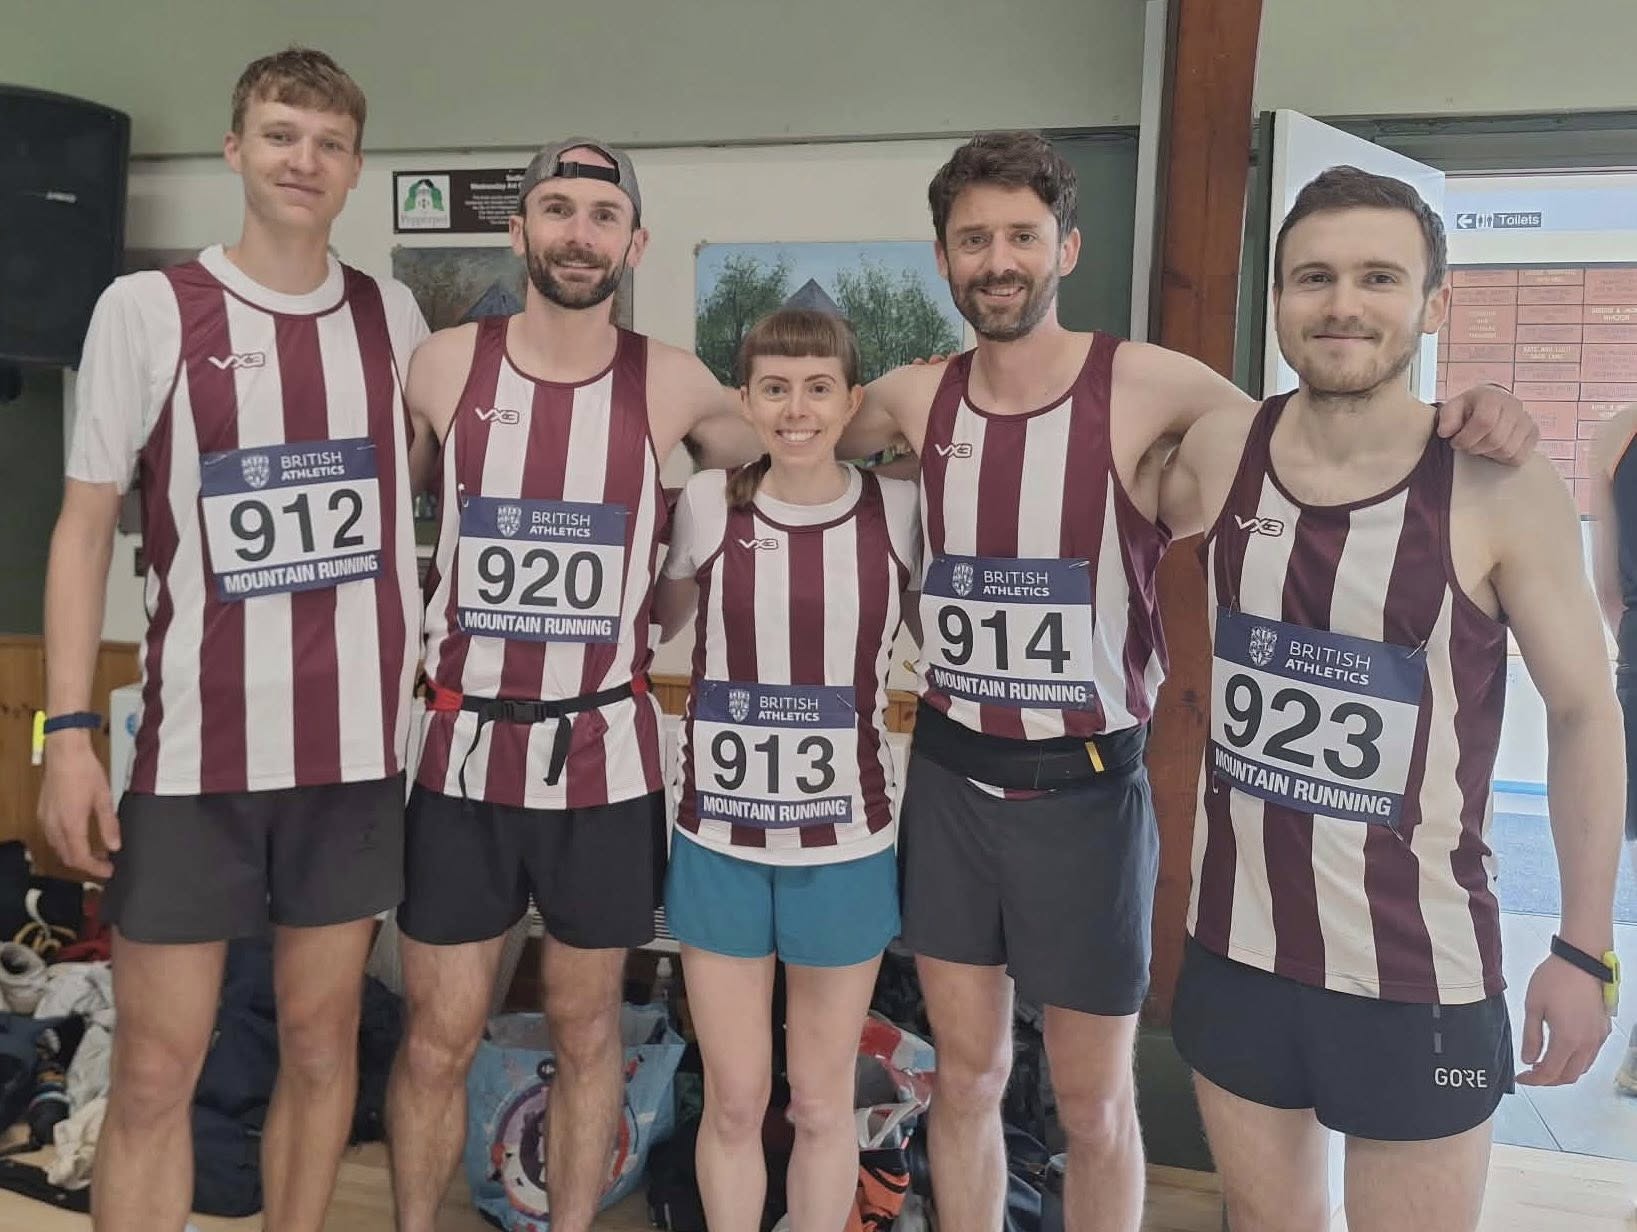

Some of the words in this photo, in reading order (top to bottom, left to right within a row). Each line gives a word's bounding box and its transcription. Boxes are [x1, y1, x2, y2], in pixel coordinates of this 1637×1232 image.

[1499, 213, 1541, 227] Toilets
[208, 352, 265, 370] VX3
[475, 407, 520, 424] VX3
[280, 451, 343, 470] BRITISH
[935, 443, 972, 458] VX3
[280, 465, 345, 481] ATHLETICS
[230, 488, 364, 562] 912
[532, 511, 591, 526] BRITISH
[1234, 514, 1285, 537] VX3
[529, 526, 591, 538] ATHLETICS
[738, 538, 779, 550] VX3
[223, 563, 316, 594] MOUNTAIN
[318, 554, 378, 580] RUNNING
[478, 546, 603, 610] 920
[983, 570, 1049, 584] BRITISH
[982, 585, 1050, 597] ATHLETICS
[464, 611, 541, 634] MOUNTAIN
[544, 618, 612, 636] RUNNING
[938, 605, 1070, 673] 914
[1289, 640, 1371, 671] BRITISH
[1285, 658, 1370, 686] ATHLETICS
[934, 668, 1006, 699] MOUNTAIN
[1009, 683, 1086, 703] RUNNING
[759, 696, 819, 710] BRITISH
[758, 710, 820, 722] ATHLETICS
[1223, 674, 1384, 780] 923
[711, 730, 835, 794] 913
[1215, 746, 1290, 796] MOUNTAIN
[1293, 780, 1393, 817] RUNNING
[703, 794, 775, 822] MOUNTAIN
[779, 800, 847, 822] RUNNING
[1434, 1067, 1488, 1088] GORE
